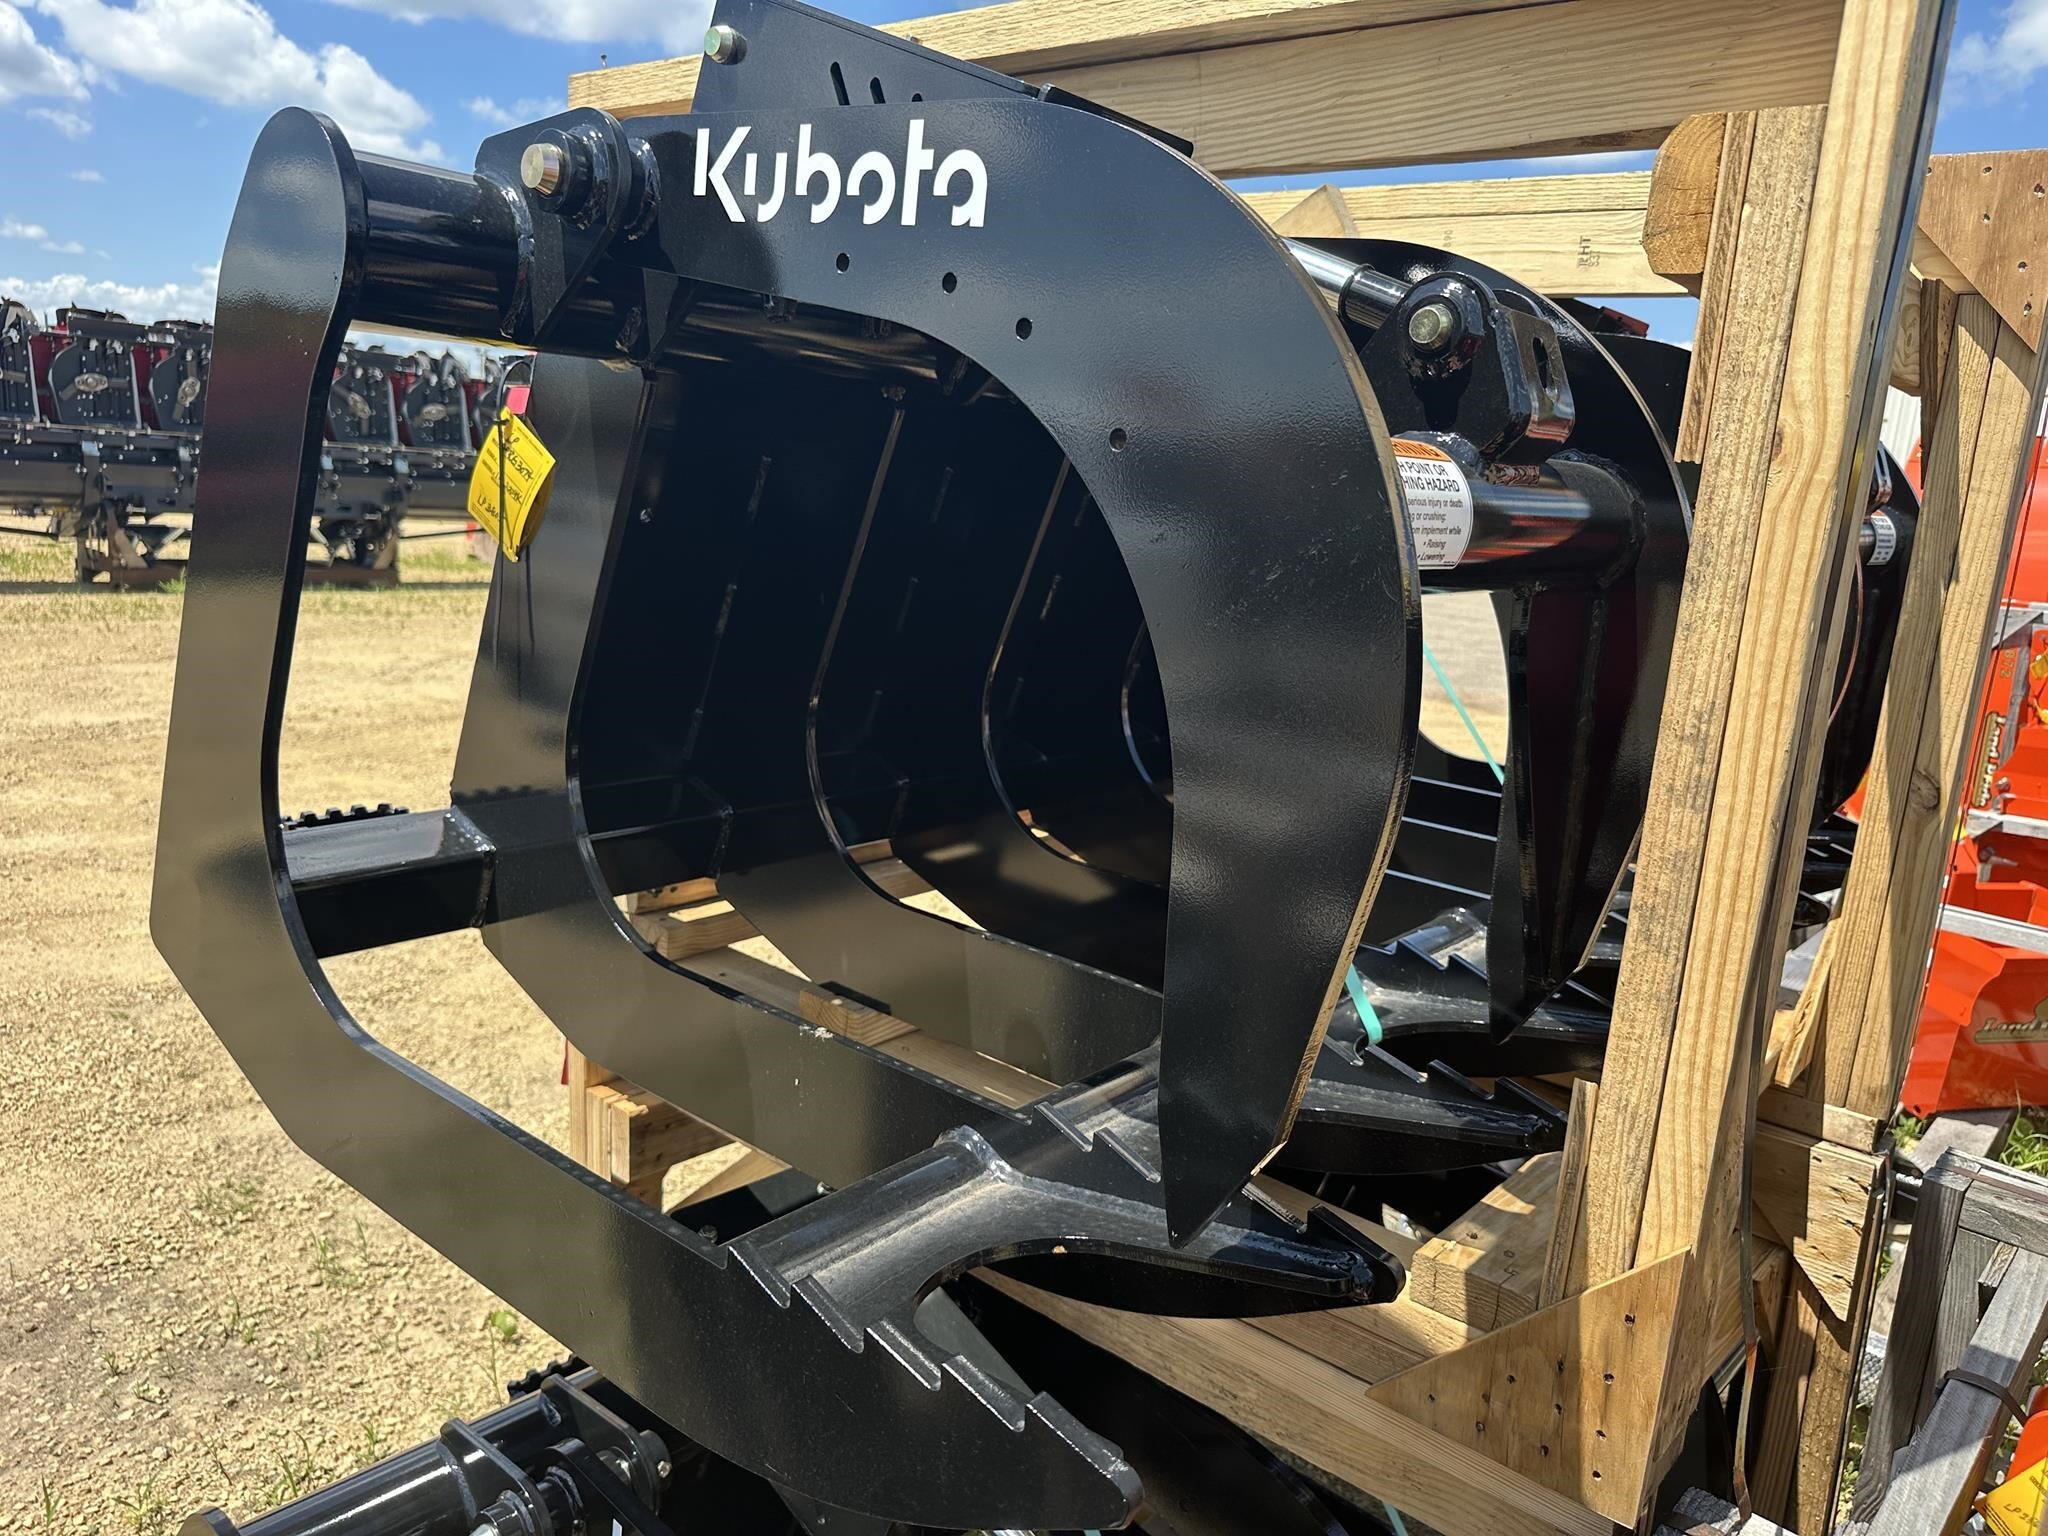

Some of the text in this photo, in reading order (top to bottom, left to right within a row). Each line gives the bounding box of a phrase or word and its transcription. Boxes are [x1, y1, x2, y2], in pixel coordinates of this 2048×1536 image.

[693, 118, 988, 227] Kubota
[1405, 461, 1434, 476] POINT
[1433, 464, 1448, 476] OR
[1425, 478, 1460, 492] HAZARD
